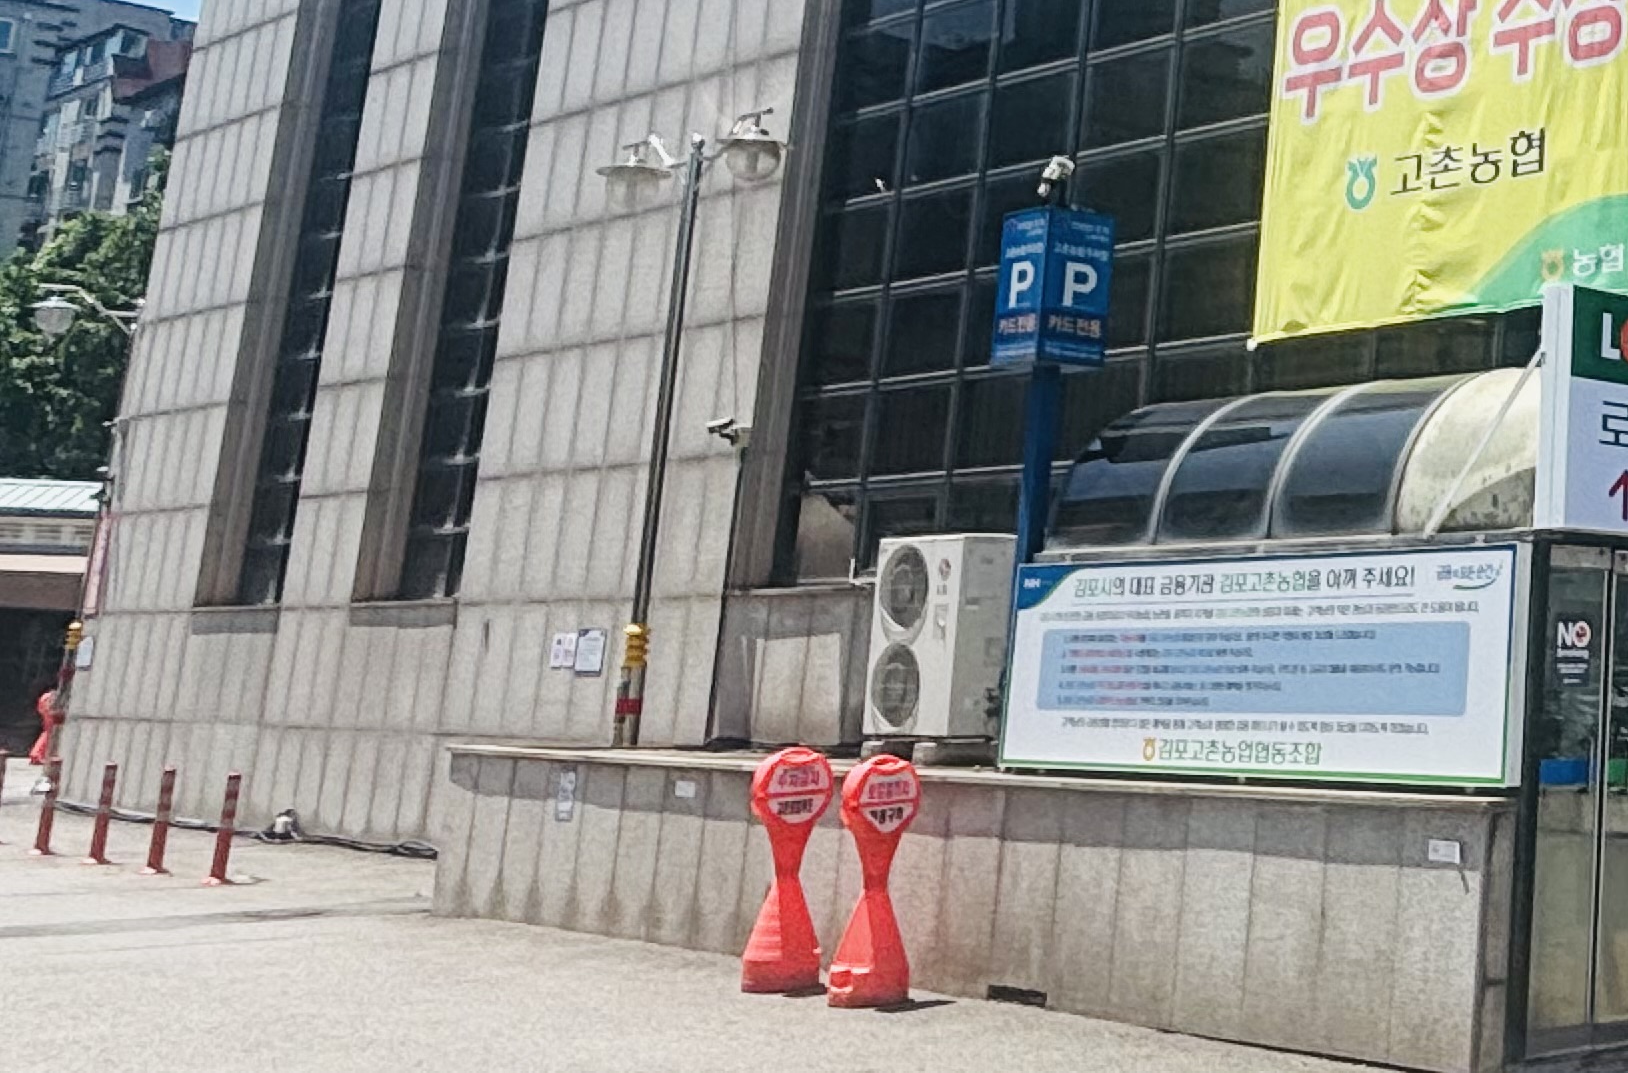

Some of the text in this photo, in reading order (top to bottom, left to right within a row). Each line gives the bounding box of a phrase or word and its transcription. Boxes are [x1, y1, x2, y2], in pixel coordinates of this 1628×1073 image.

[1390, 128, 1546, 195] 고촌농협
[1571, 243, 1625, 276] 농협
[1008, 260, 1035, 309] P
[1062, 261, 1098, 307] P
[1074, 565, 1415, 598] 김포시의 대표 금융기관 김포고촌농협을 아껴 주세요!
[1158, 738, 1322, 765] 김포고촌농업협동조합
